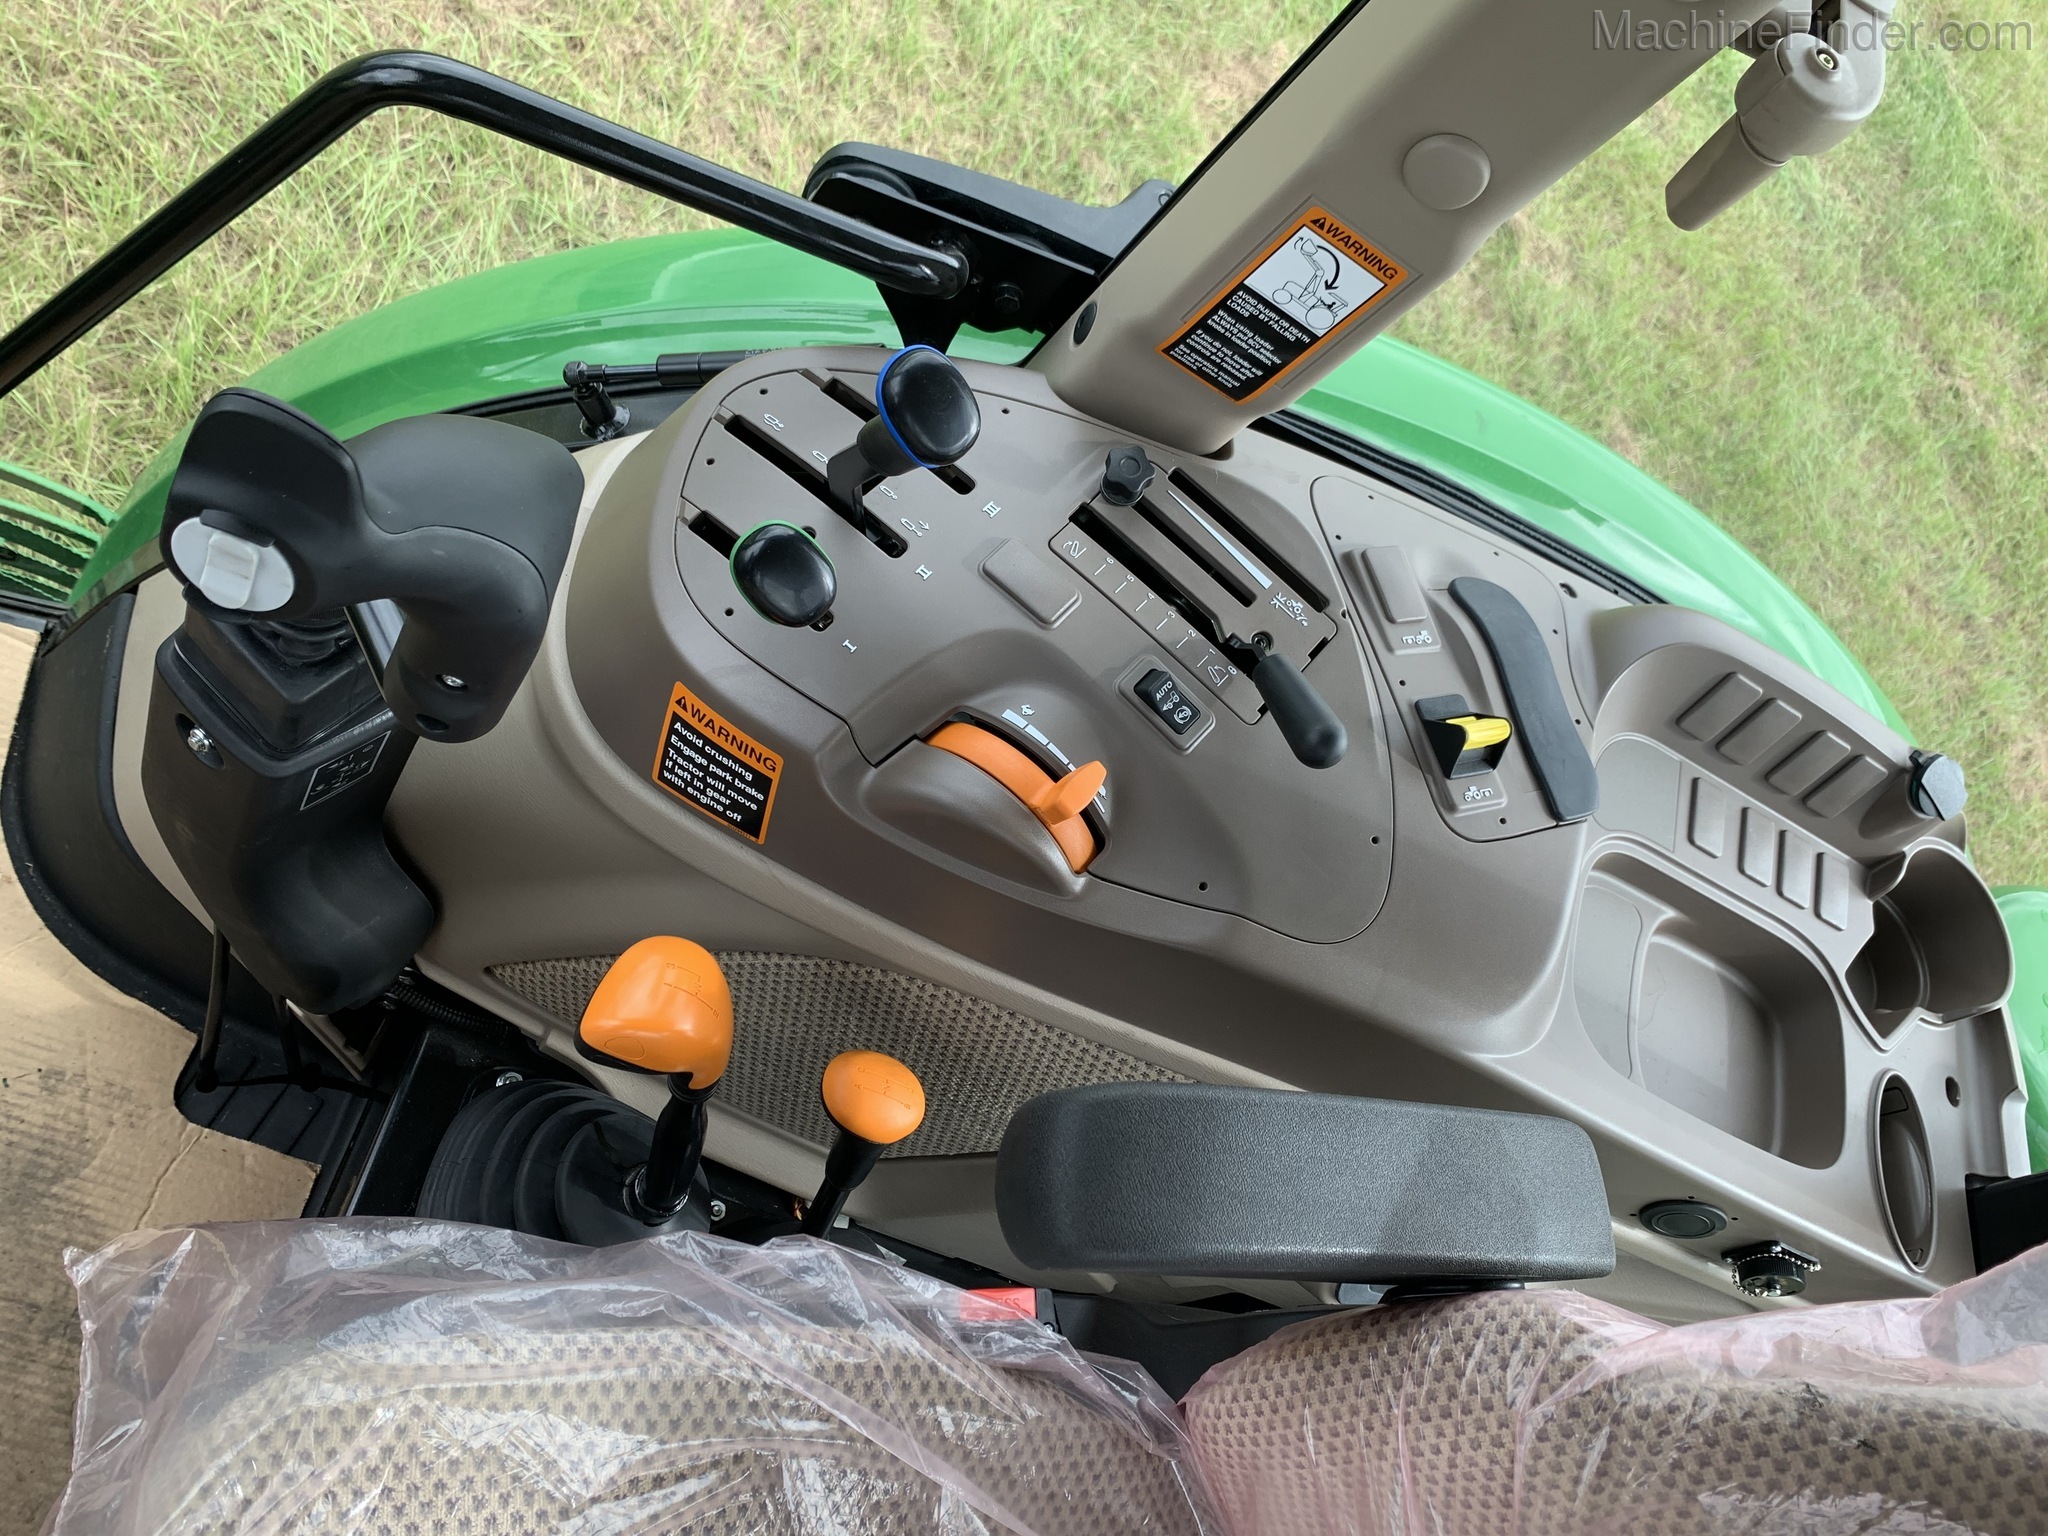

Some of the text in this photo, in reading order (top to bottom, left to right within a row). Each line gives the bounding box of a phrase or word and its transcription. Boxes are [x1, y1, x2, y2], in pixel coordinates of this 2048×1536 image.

[1326, 222, 1398, 281] WARNING
[1218, 310, 1274, 351] When using loader
[1227, 300, 1250, 317] LOADS
[1232, 295, 1296, 342] CAUSED BY FALLING
[1237, 291, 1311, 343] AVOID INJURY OR DEATH
[1186, 339, 1211, 356] controls
[1221, 362, 1247, 380] released.
[1191, 335, 1217, 353] continue
[1224, 357, 1241, 369] move
[1240, 368, 1254, 378] after
[1200, 333, 1214, 343] you
[1221, 347, 1233, 357] not,
[1233, 355, 1252, 368] loader
[1251, 368, 1263, 376] will
[1207, 319, 1225, 333] knobs
[1231, 335, 1250, 349] loader
[1248, 348, 1272, 366] position.
[1212, 315, 1282, 364] ALWAYS put SCV selector
[1188, 629, 1196, 638] 2
[1156, 681, 1172, 700] AUTO
[674, 722, 753, 781] Avoid crushing
[690, 703, 776, 773] WARNING
[665, 758, 731, 805] if left in gear
[668, 748, 757, 810] Tractor will move
[671, 734, 764, 801] Engage park brake
[664, 770, 742, 822] with engine off
